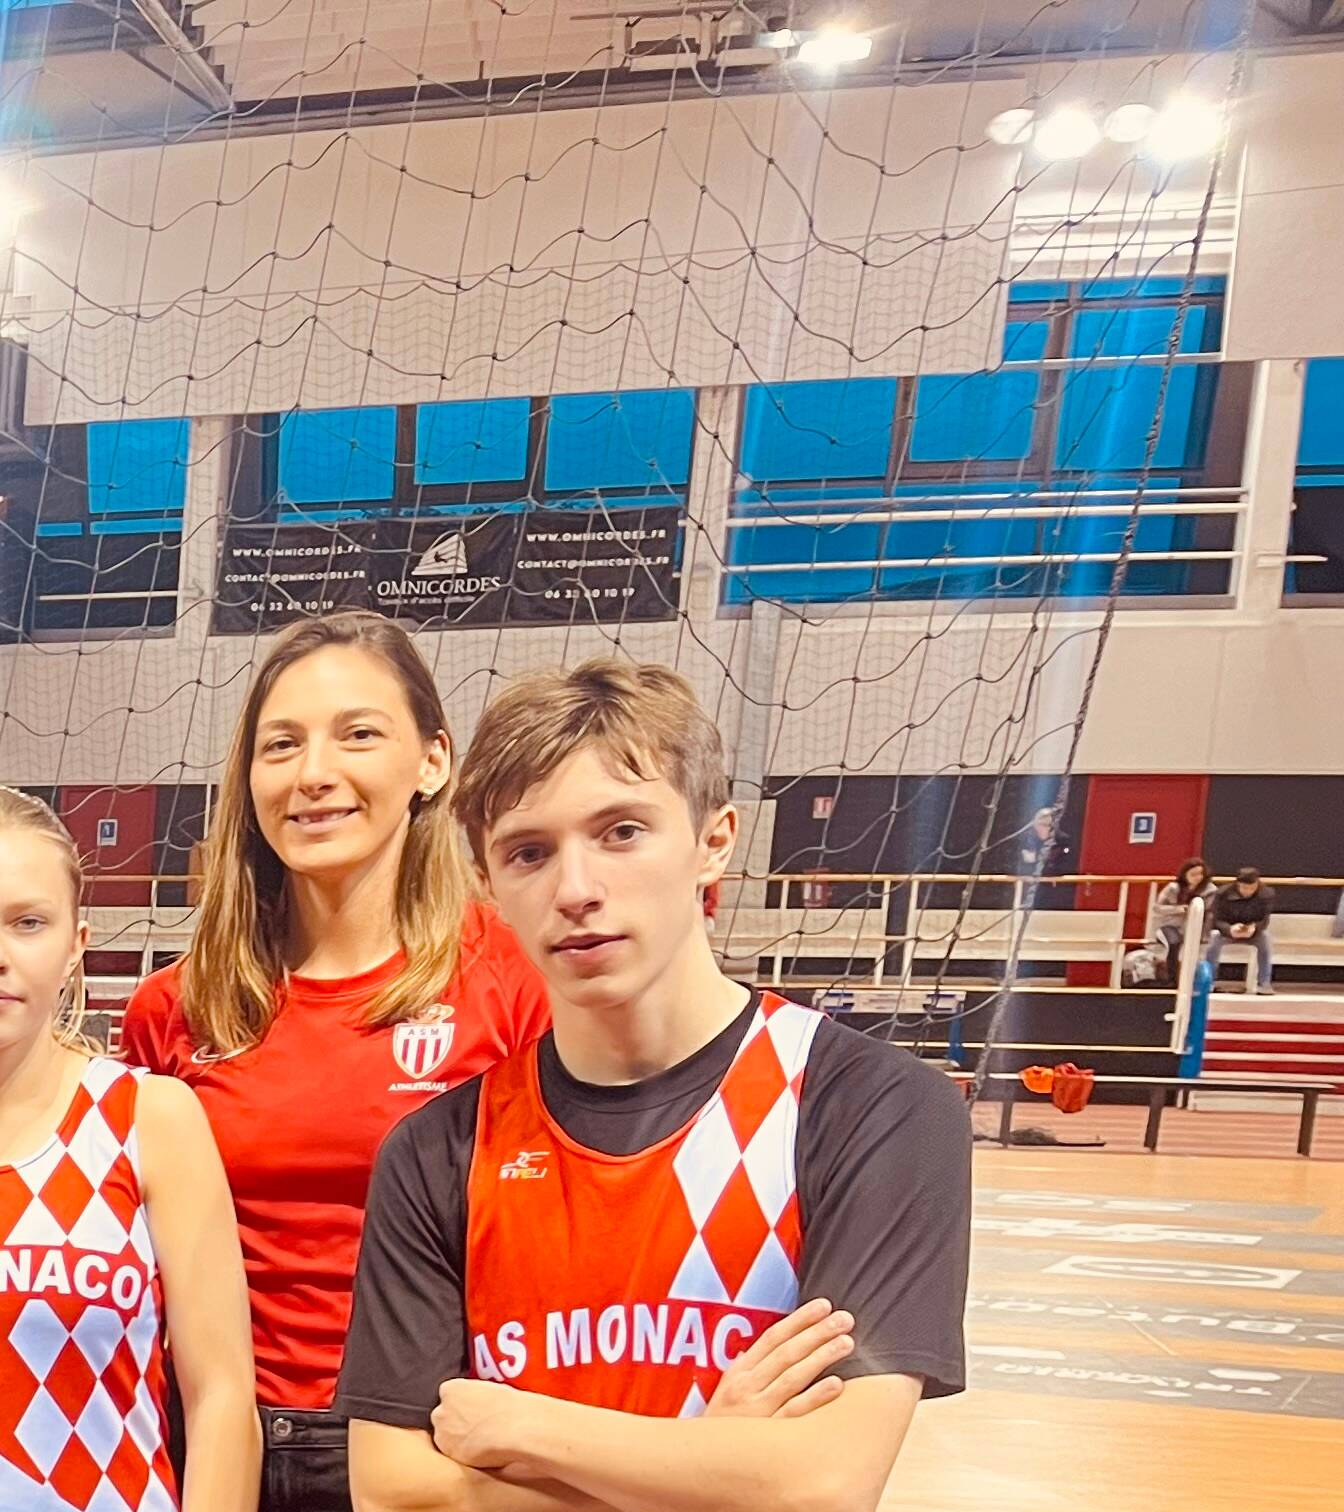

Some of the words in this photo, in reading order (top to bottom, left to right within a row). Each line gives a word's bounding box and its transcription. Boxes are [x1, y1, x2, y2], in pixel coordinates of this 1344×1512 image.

[377, 576, 501, 596] OMNICORDES
[407, 1028, 440, 1036] ASM
[473, 1320, 528, 1383] AS
